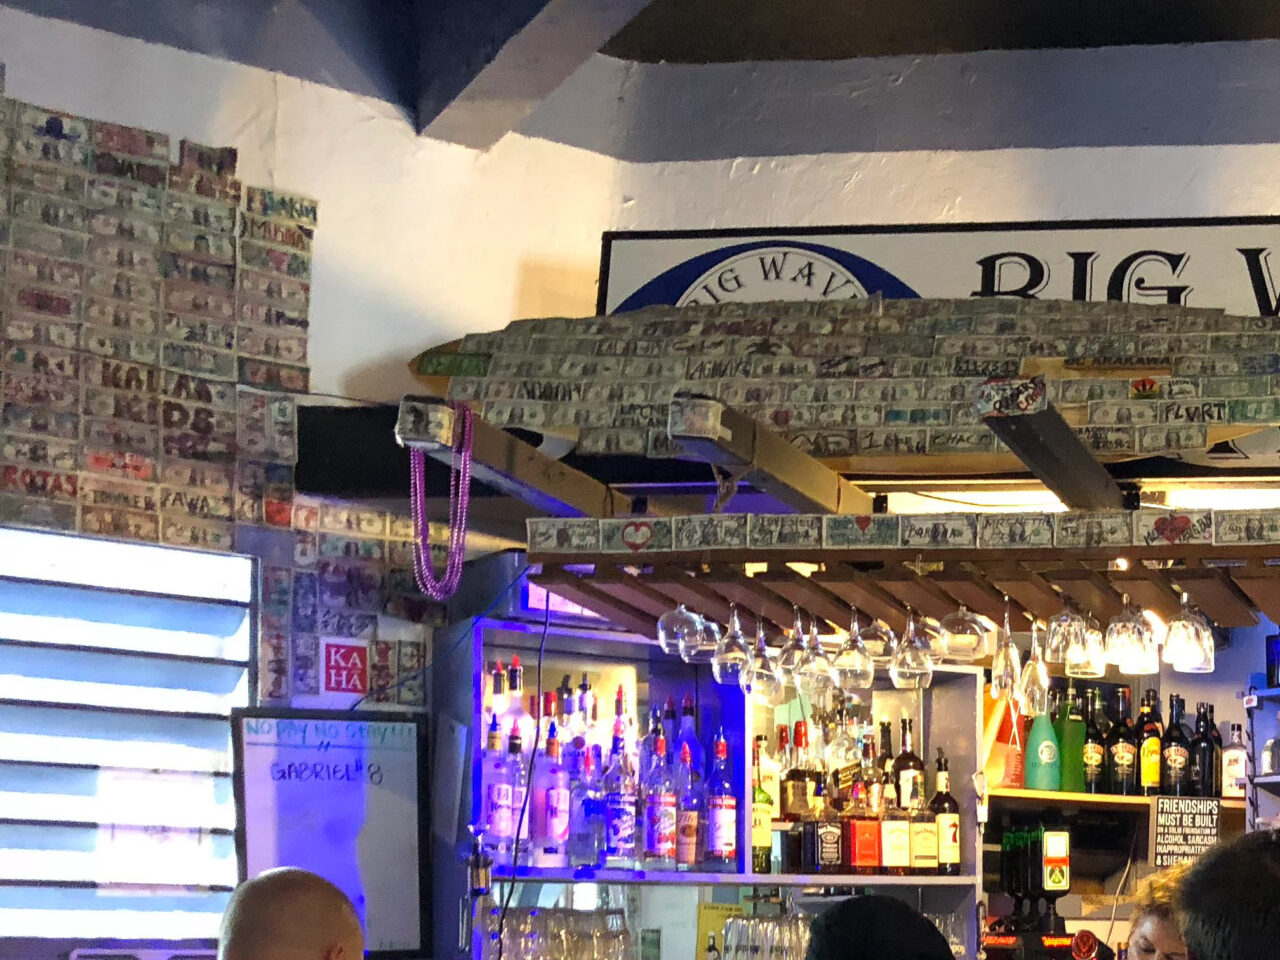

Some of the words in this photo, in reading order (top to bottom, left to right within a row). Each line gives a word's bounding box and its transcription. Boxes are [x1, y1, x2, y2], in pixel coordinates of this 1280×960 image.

[688, 267, 743, 304] IG
[757, 251, 857, 300] WAV
[970, 250, 1190, 304] BIG
[330, 647, 362, 668] KA
[245, 720, 272, 734] NO
[1158, 798, 1218, 815] FRIENDSHIPS
[1157, 813, 1181, 826] MUST
[1182, 814, 1193, 826] BE
[1195, 815, 1218, 827] BUILT
[1156, 844, 1208, 854] INAPPROPRIATEN
